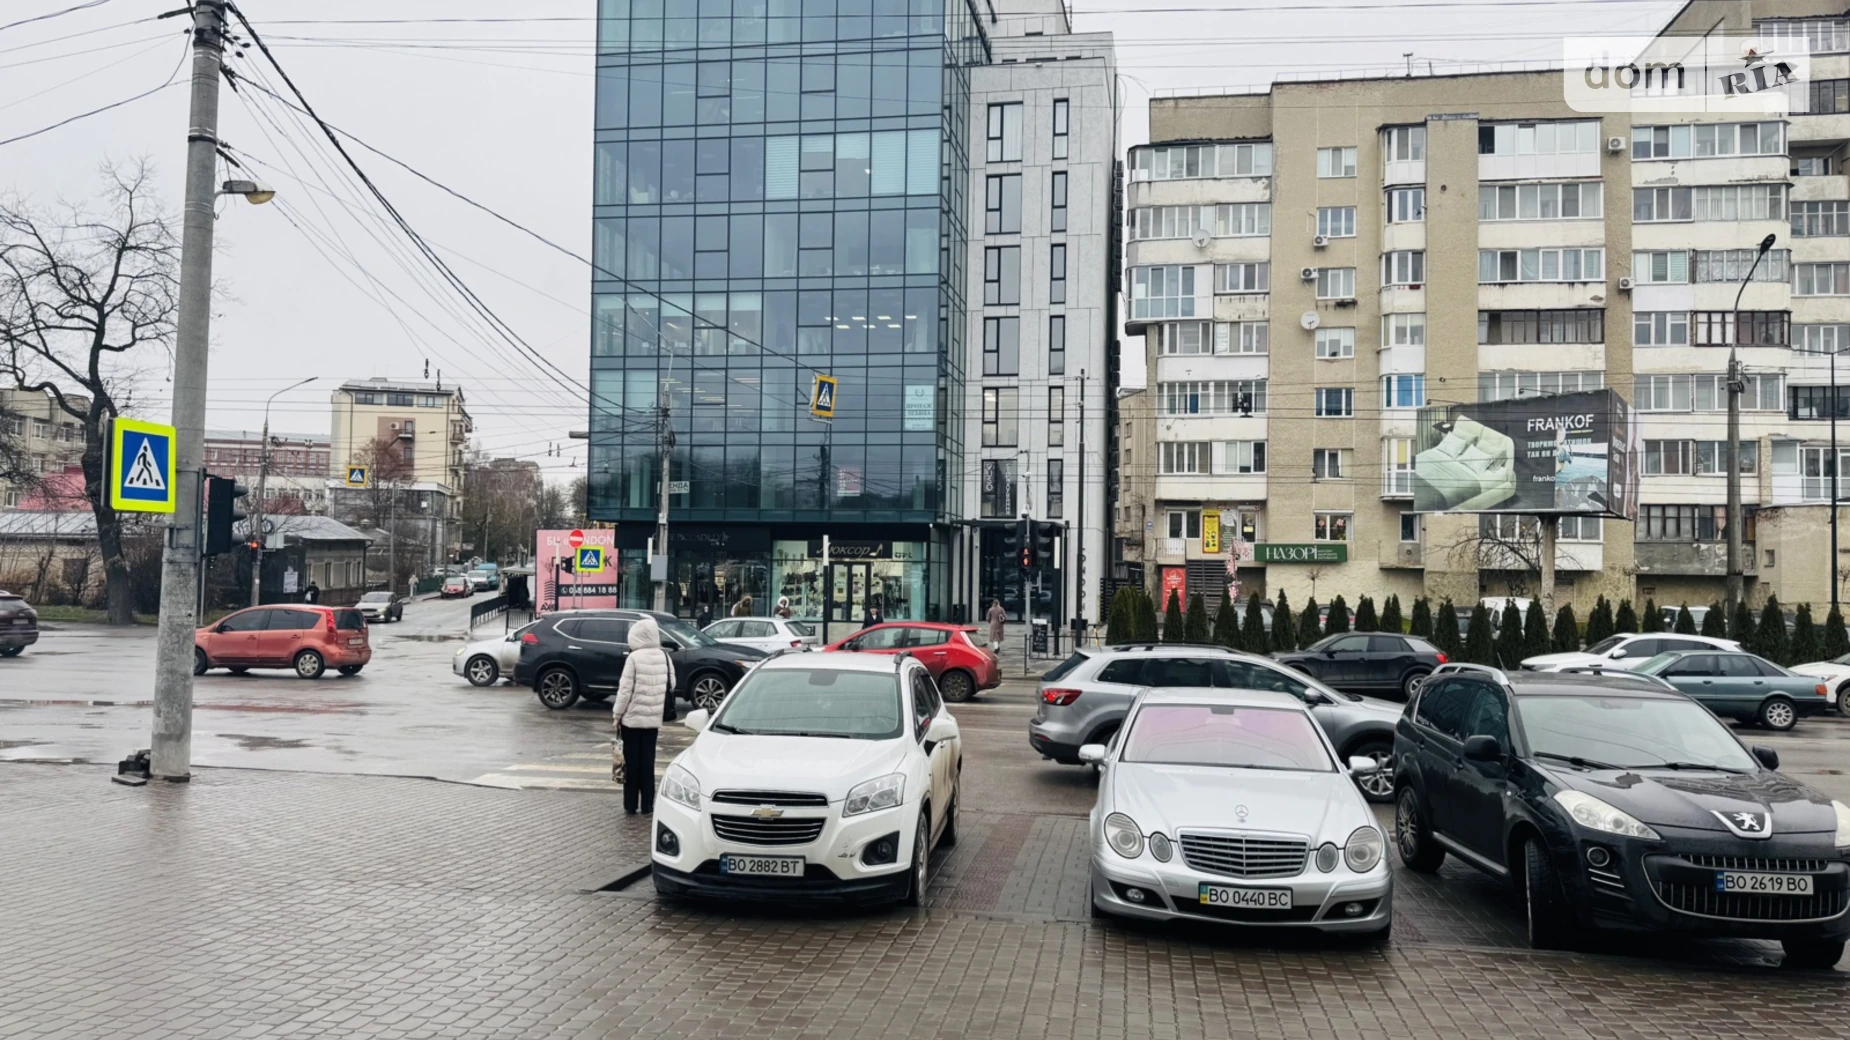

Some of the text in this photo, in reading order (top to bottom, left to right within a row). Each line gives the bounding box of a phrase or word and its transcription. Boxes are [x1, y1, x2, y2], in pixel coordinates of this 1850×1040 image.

[1527, 413, 1594, 432] FRANKOF
[1562, 437, 1592, 446] АТИШОК
[1266, 545, 1318, 560] НАЗОРІ
[728, 859, 799, 874] BO 2882 BT
[1725, 875, 1808, 891] BO 2619 BO
[1209, 888, 1288, 906] BO 0440 BC
